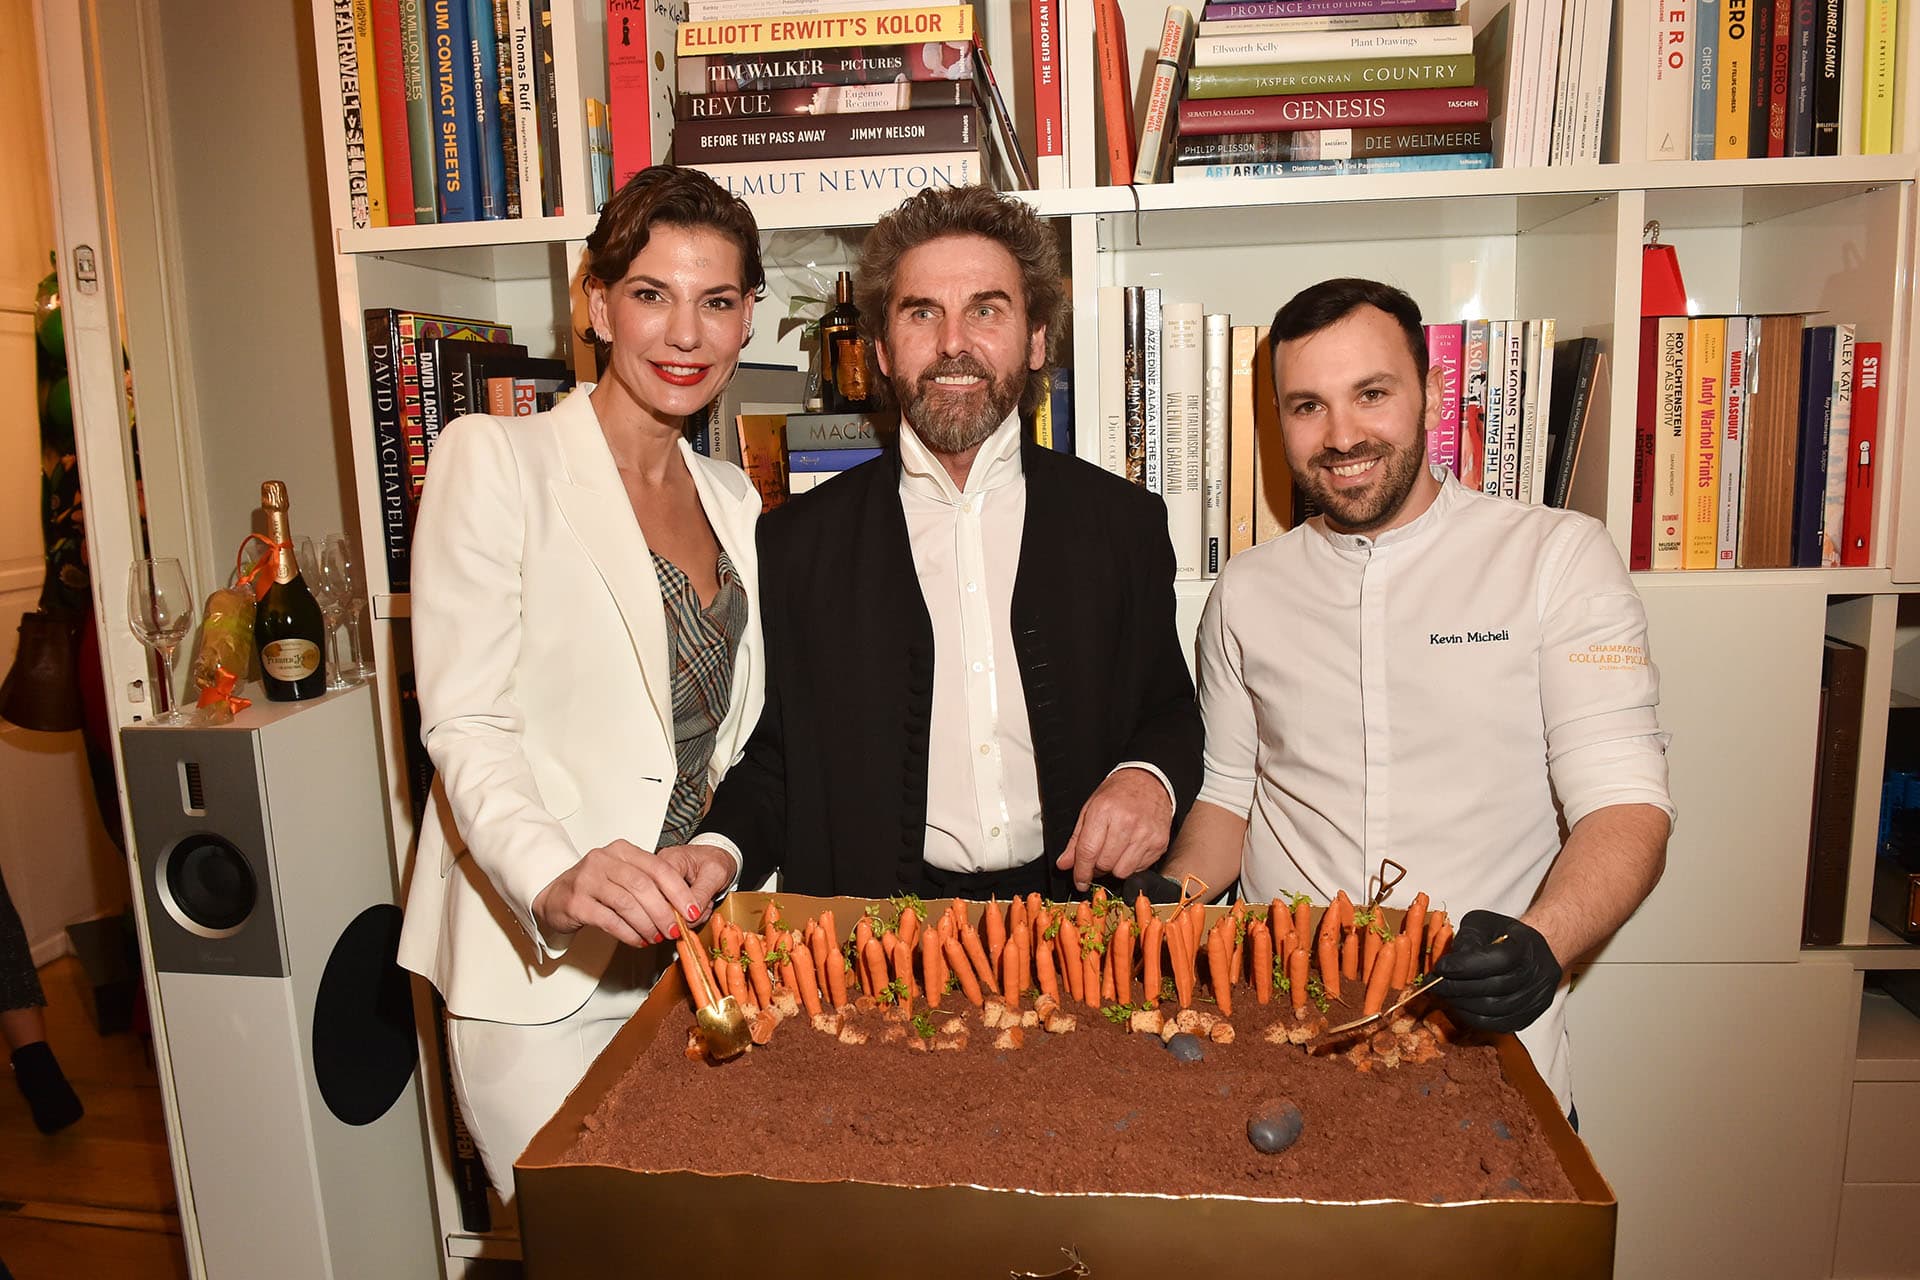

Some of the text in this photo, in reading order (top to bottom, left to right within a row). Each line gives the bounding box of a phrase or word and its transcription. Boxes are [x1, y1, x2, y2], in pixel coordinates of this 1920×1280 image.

[654, 1, 667, 16] Der
[685, 13, 942, 46] ELLIOTT ERWITT'S KOLOR
[1230, 2, 1303, 16] PROVENCE
[1040, 6, 1051, 84] THE EUROPEAN
[1161, 20, 1175, 57] ESCHBACH
[1168, 24, 1182, 58] ANDREAS
[1212, 36, 1418, 54] Ellsworth Kelly Plant Drawings
[1668, 0, 1685, 69] ERO
[407, 15, 423, 100] MILLION MILES
[436, 34, 455, 117] CONTACT
[515, 26, 531, 111] Thomas Ruff
[707, 57, 903, 81] TIM WALKER PICTURES
[1255, 65, 1458, 88] JASPER CONRAN COUNTRY
[1701, 46, 1712, 91] CIRCUS
[1774, 44, 1787, 95] BOTERO
[844, 89, 884, 99] Eugenio
[844, 99, 889, 109] Recuenco
[1146, 76, 1164, 134] MANN DER WELT
[1163, 76, 1171, 92] DER
[692, 94, 772, 117] REVUE
[1223, 109, 1255, 117] SALGADO
[1282, 97, 1385, 121] GENESIS
[1447, 100, 1479, 108] TASCHEN
[442, 122, 460, 193] SHEETS
[701, 125, 925, 148] BEFORE THEY PASS AWAY JIMMY NELSON
[1184, 132, 1481, 154] PHILIP PLISSON DIE WELTMEERE
[712, 165, 951, 196] LMUT NEWTON
[1205, 164, 1284, 178] ARTARKTIS
[1663, 332, 1675, 427] KUNST ALS MOTIV
[1673, 332, 1684, 437] ROY LICHTENSTEIN
[1839, 333, 1853, 402] ALEX KATZ
[1862, 357, 1878, 389] STIK
[398, 314, 426, 503] LACHAPELL
[420, 352, 439, 453] DAVID LACHAPE
[1128, 379, 1141, 412] JIMMY
[1147, 328, 1157, 489] AZZEDINE IN THE 21ST
[1440, 354, 1457, 467] JAMES TUR
[1727, 350, 1742, 441] WARHOL BASQUIAT
[809, 421, 871, 441] MACK
[1107, 415, 1120, 443] Dior
[1128, 415, 1142, 459] CHOO
[1166, 391, 1183, 495] VALENTINO GARAVANI
[1187, 394, 1198, 492] EINE ITALIENISCHE LEGENDE
[1205, 366, 1225, 480] CHANEL
[1487, 387, 1501, 473] THE PAINTER
[1504, 425, 1517, 450] THE
[1645, 433, 1653, 455] ROY
[1697, 377, 1717, 488] Andy Warhol Prints
[373, 344, 405, 559] DAVID LACHAPELLE
[1502, 454, 1515, 499] SCULP
[1521, 455, 1531, 495] BASQUIAT
[1429, 630, 1510, 645] Kevin Micheli
